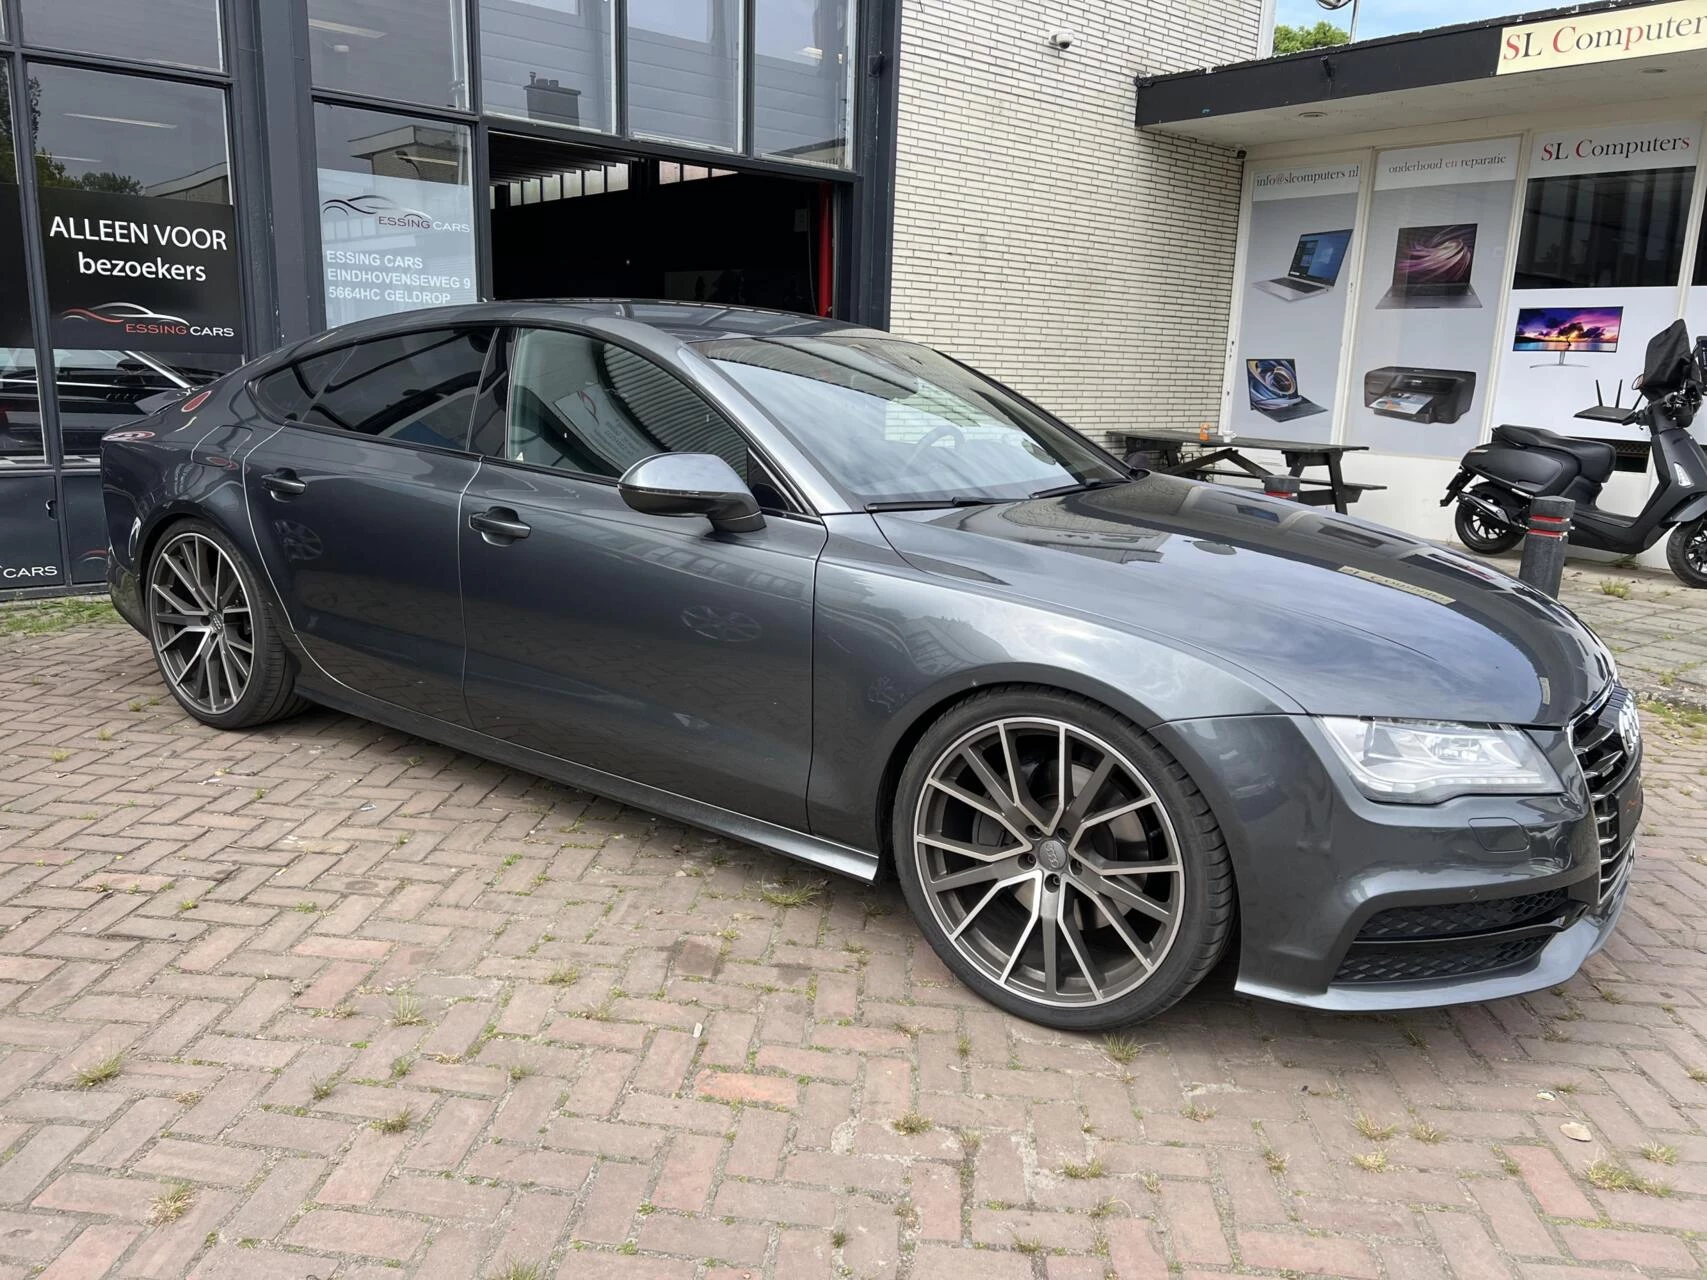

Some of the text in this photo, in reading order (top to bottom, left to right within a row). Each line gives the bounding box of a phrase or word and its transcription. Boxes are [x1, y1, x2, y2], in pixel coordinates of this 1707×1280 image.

[1503, 32, 1543, 60] SL
[1541, 136, 1690, 161] SL Computers
[1388, 153, 1507, 174] onderhoud en reparatie
[49, 216, 228, 251] ALLEEN VOOR
[378, 216, 471, 233] ESSING CARS
[78, 251, 207, 282] bezoekers
[326, 250, 424, 269] ESSING CARS
[327, 268, 471, 289] EINDHOVENSEWEG 9
[328, 286, 451, 305] 5664HC GELDROP
[125, 323, 235, 338] ESSING CARS
[3, 565, 58, 578] CARS
